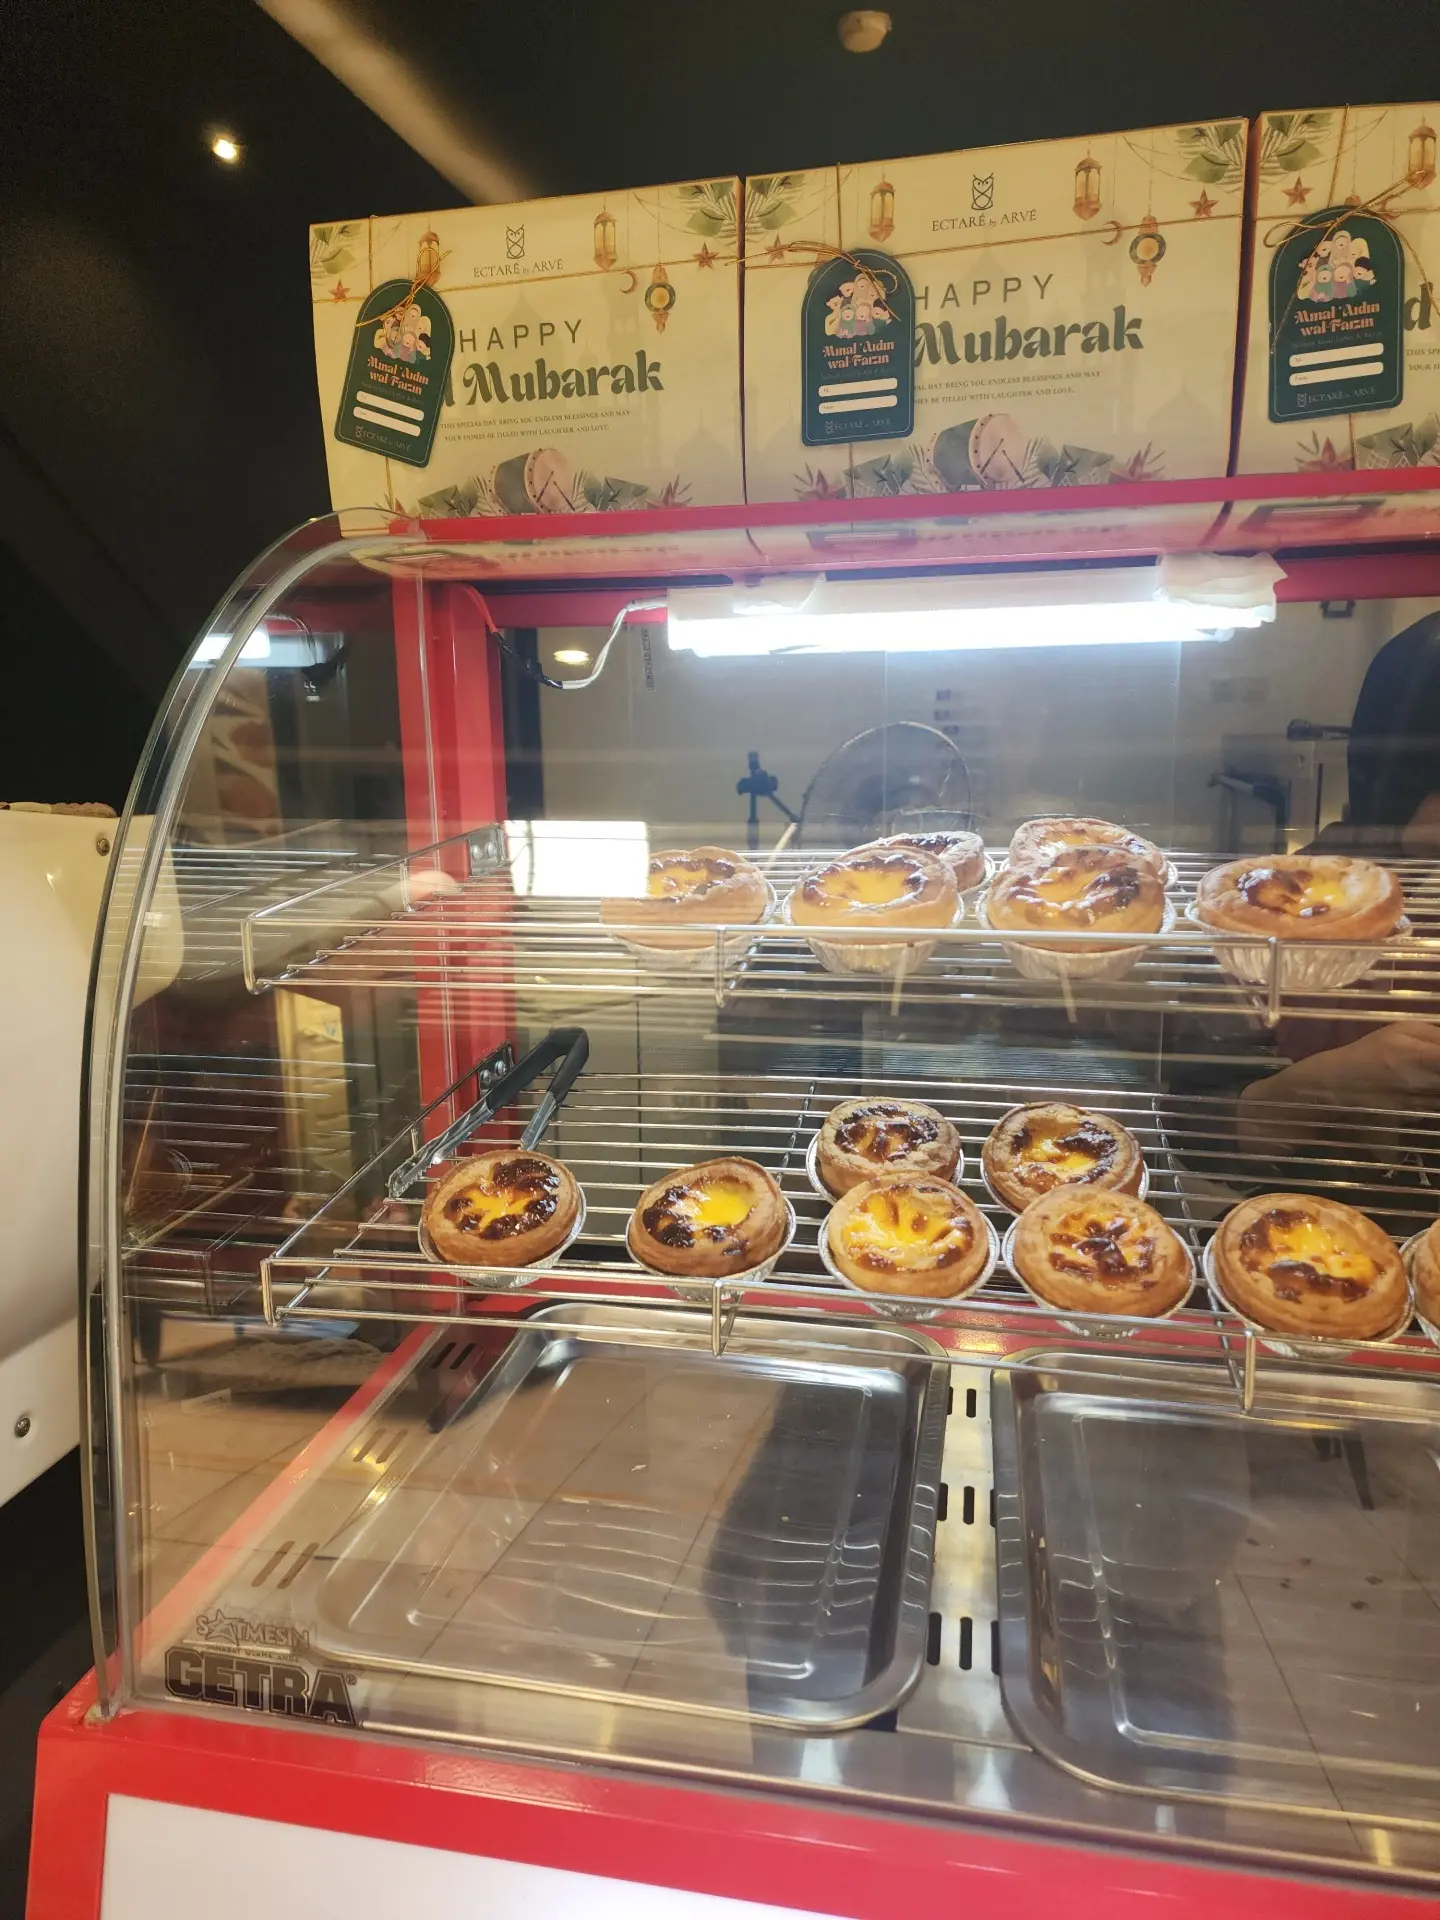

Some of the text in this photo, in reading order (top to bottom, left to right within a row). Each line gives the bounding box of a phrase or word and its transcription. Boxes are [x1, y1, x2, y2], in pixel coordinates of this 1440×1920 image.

[914, 273, 1054, 311] HAPPY
[459, 319, 582, 353] HAPPY
[914, 304, 1144, 368] Mubarak
[462, 349, 665, 406] Mubarak
[1064, 371, 1082, 379] AND
